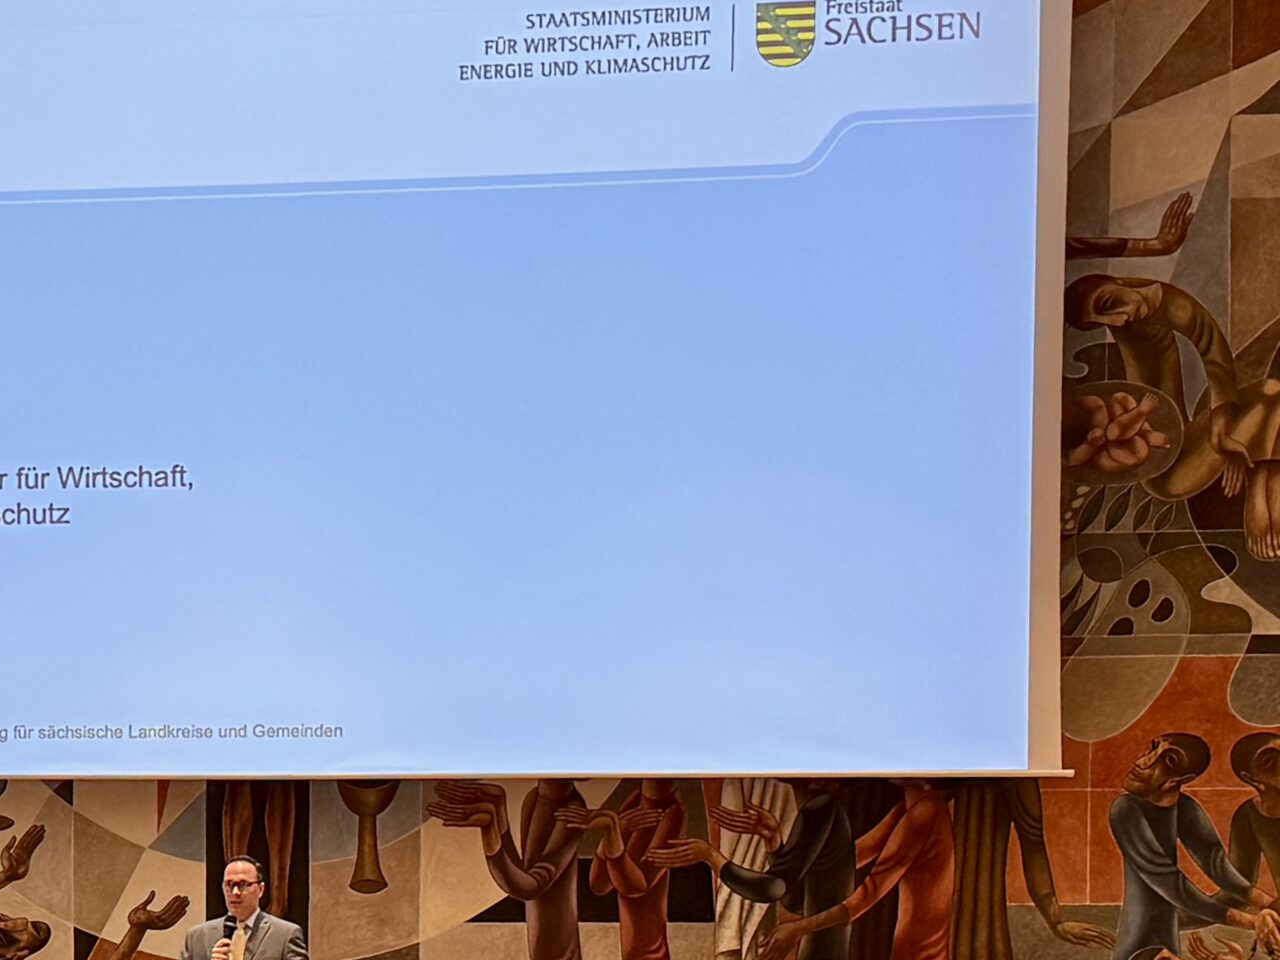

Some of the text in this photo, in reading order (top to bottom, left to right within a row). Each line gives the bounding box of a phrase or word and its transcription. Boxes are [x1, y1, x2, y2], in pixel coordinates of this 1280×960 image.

[526, 6, 711, 29] STAATSMINISTERIUM
[826, 0, 903, 15] Freistaat
[824, 11, 981, 46] SACHSEN
[484, 30, 711, 55] FÜR WIRTSCHAFT, ARBEIT
[459, 54, 711, 81] ENERGIE UND KLIMASCHUTZ
[16, 466, 50, 490] für
[57, 464, 193, 491] Wirtschaft,
[13, 724, 34, 740] für
[38, 724, 123, 740] sächsische
[128, 723, 213, 739] Landkreise
[219, 723, 247, 739] und
[252, 722, 343, 739] Gemeinden
